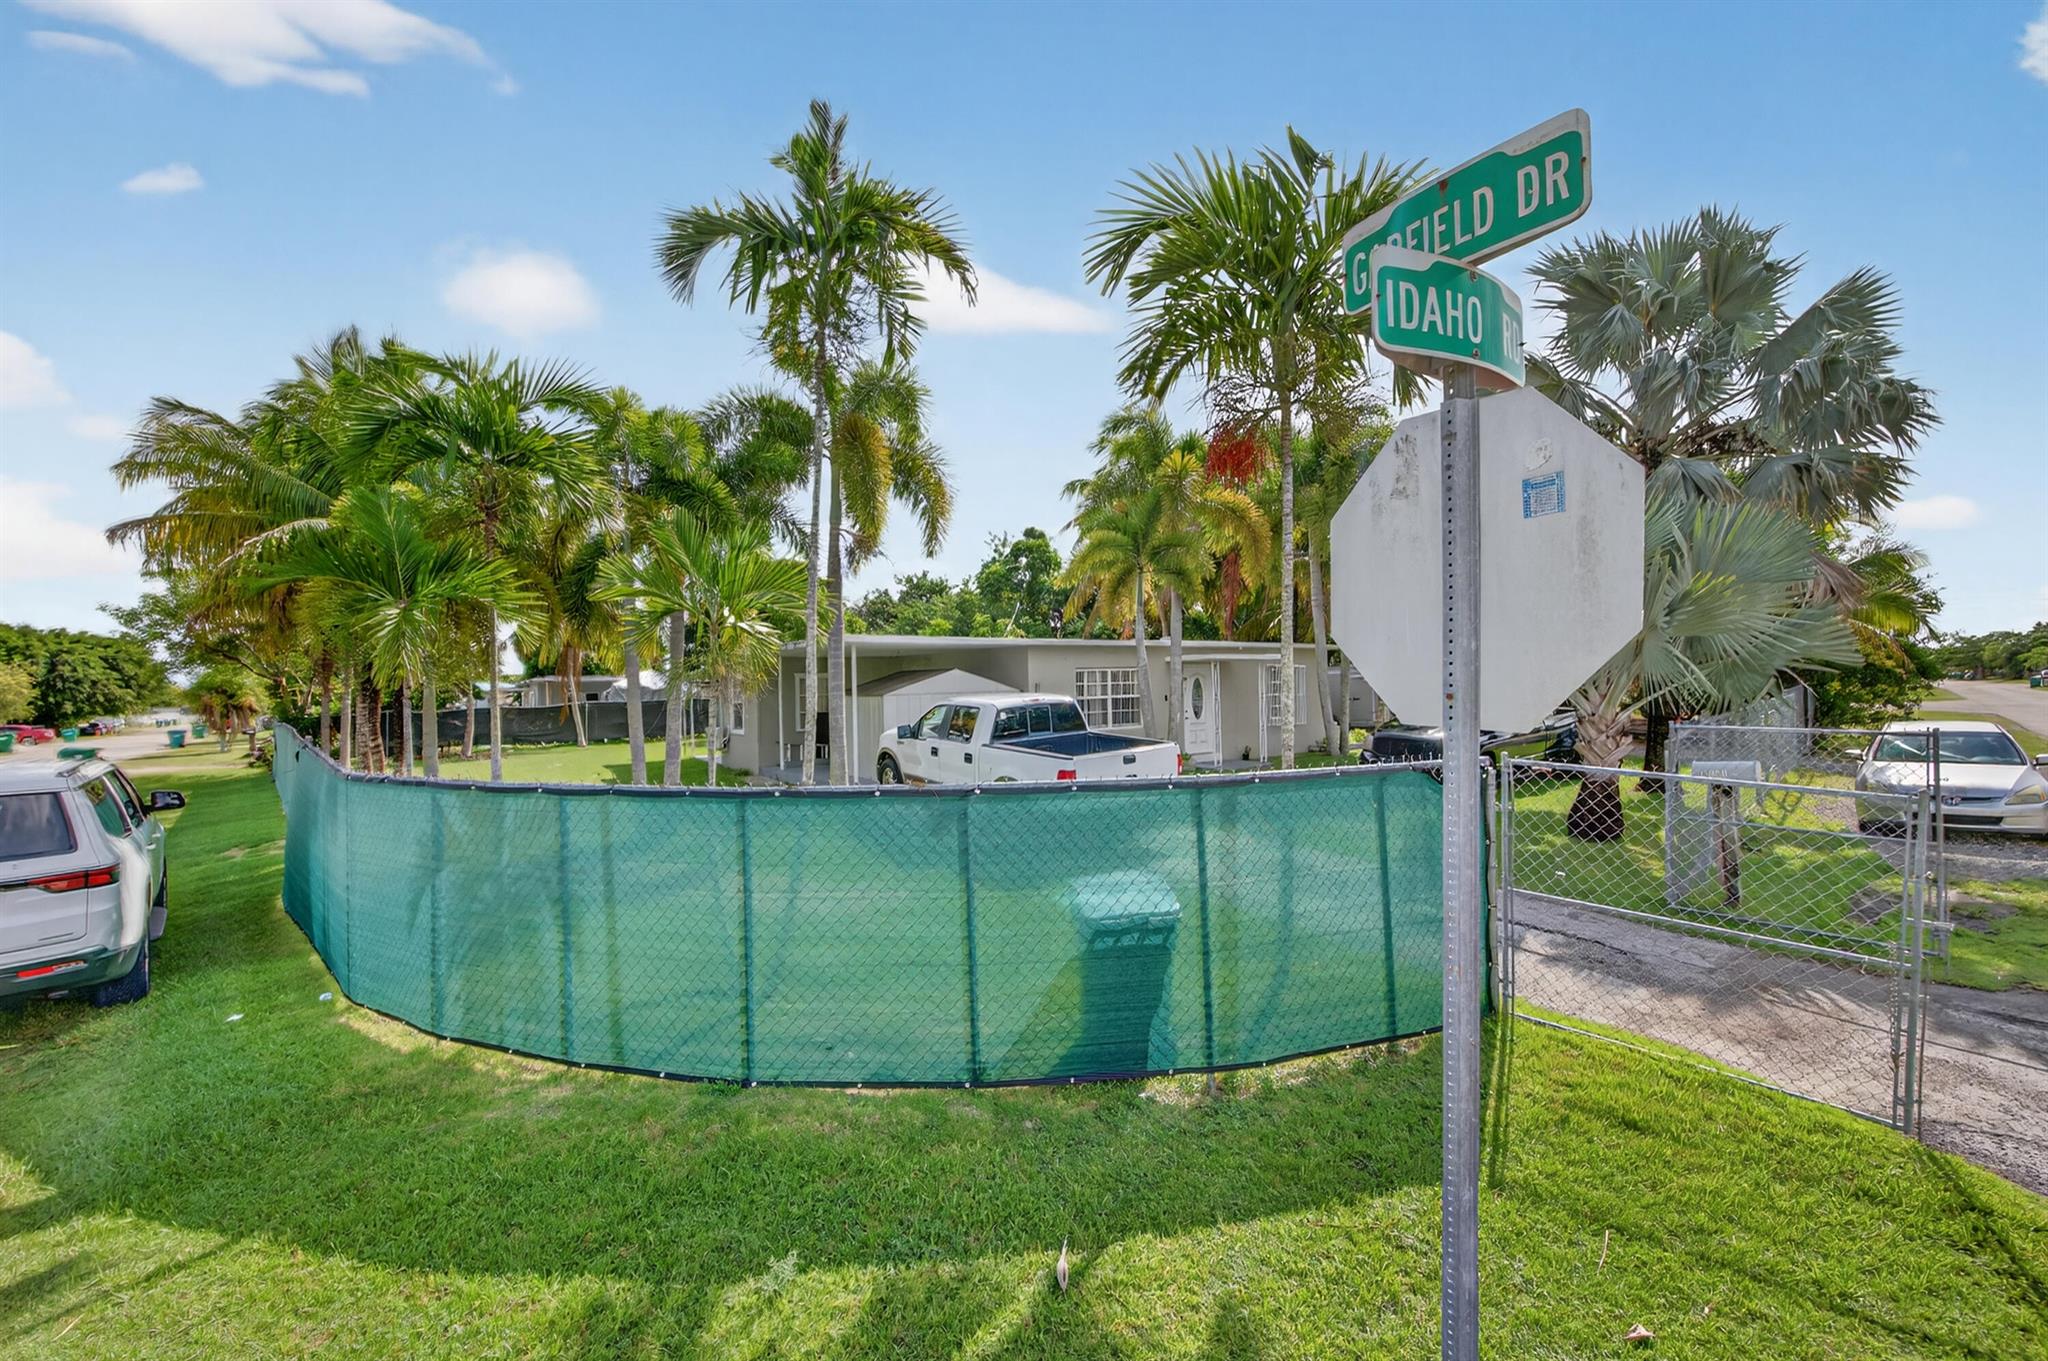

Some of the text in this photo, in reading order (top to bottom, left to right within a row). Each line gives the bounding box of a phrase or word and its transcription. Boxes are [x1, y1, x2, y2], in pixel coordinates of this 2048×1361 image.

[1353, 151, 1570, 295] GFIELD DR
[1386, 279, 1520, 364] IDAHO RD
